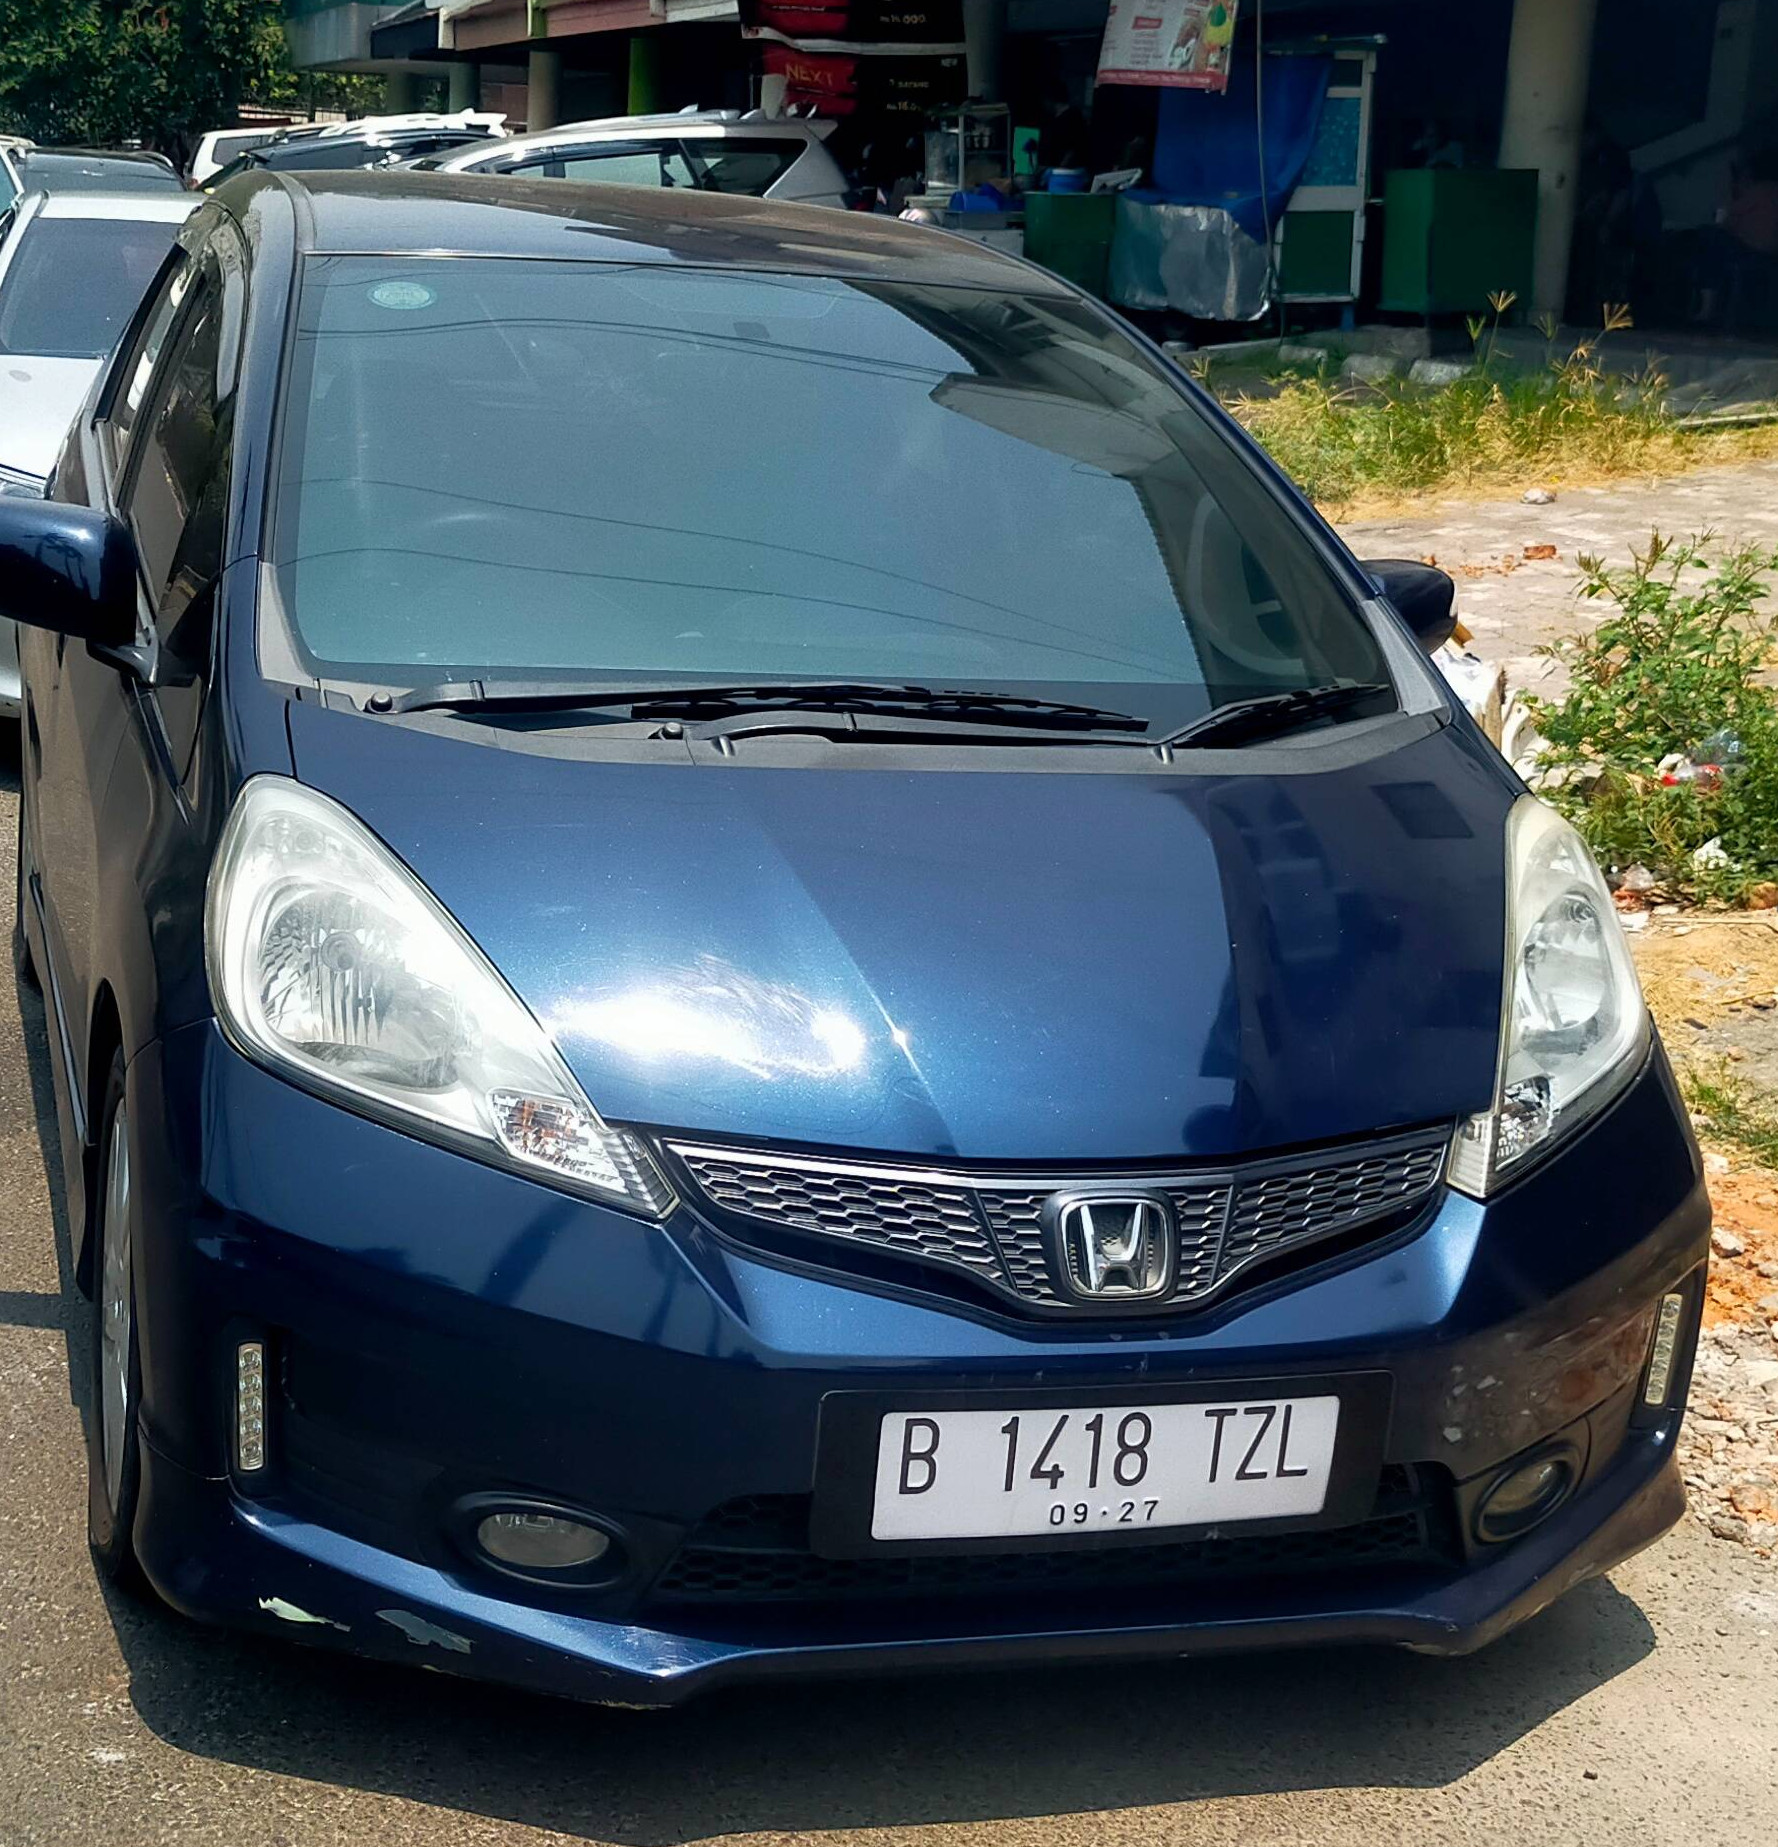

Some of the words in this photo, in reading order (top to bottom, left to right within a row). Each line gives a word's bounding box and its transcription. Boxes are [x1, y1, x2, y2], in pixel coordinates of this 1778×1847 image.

[785, 63, 834, 87] NEXT
[898, 1417, 940, 1495] B
[1001, 1411, 1152, 1492] 1418
[1204, 1404, 1308, 1483] TZL
